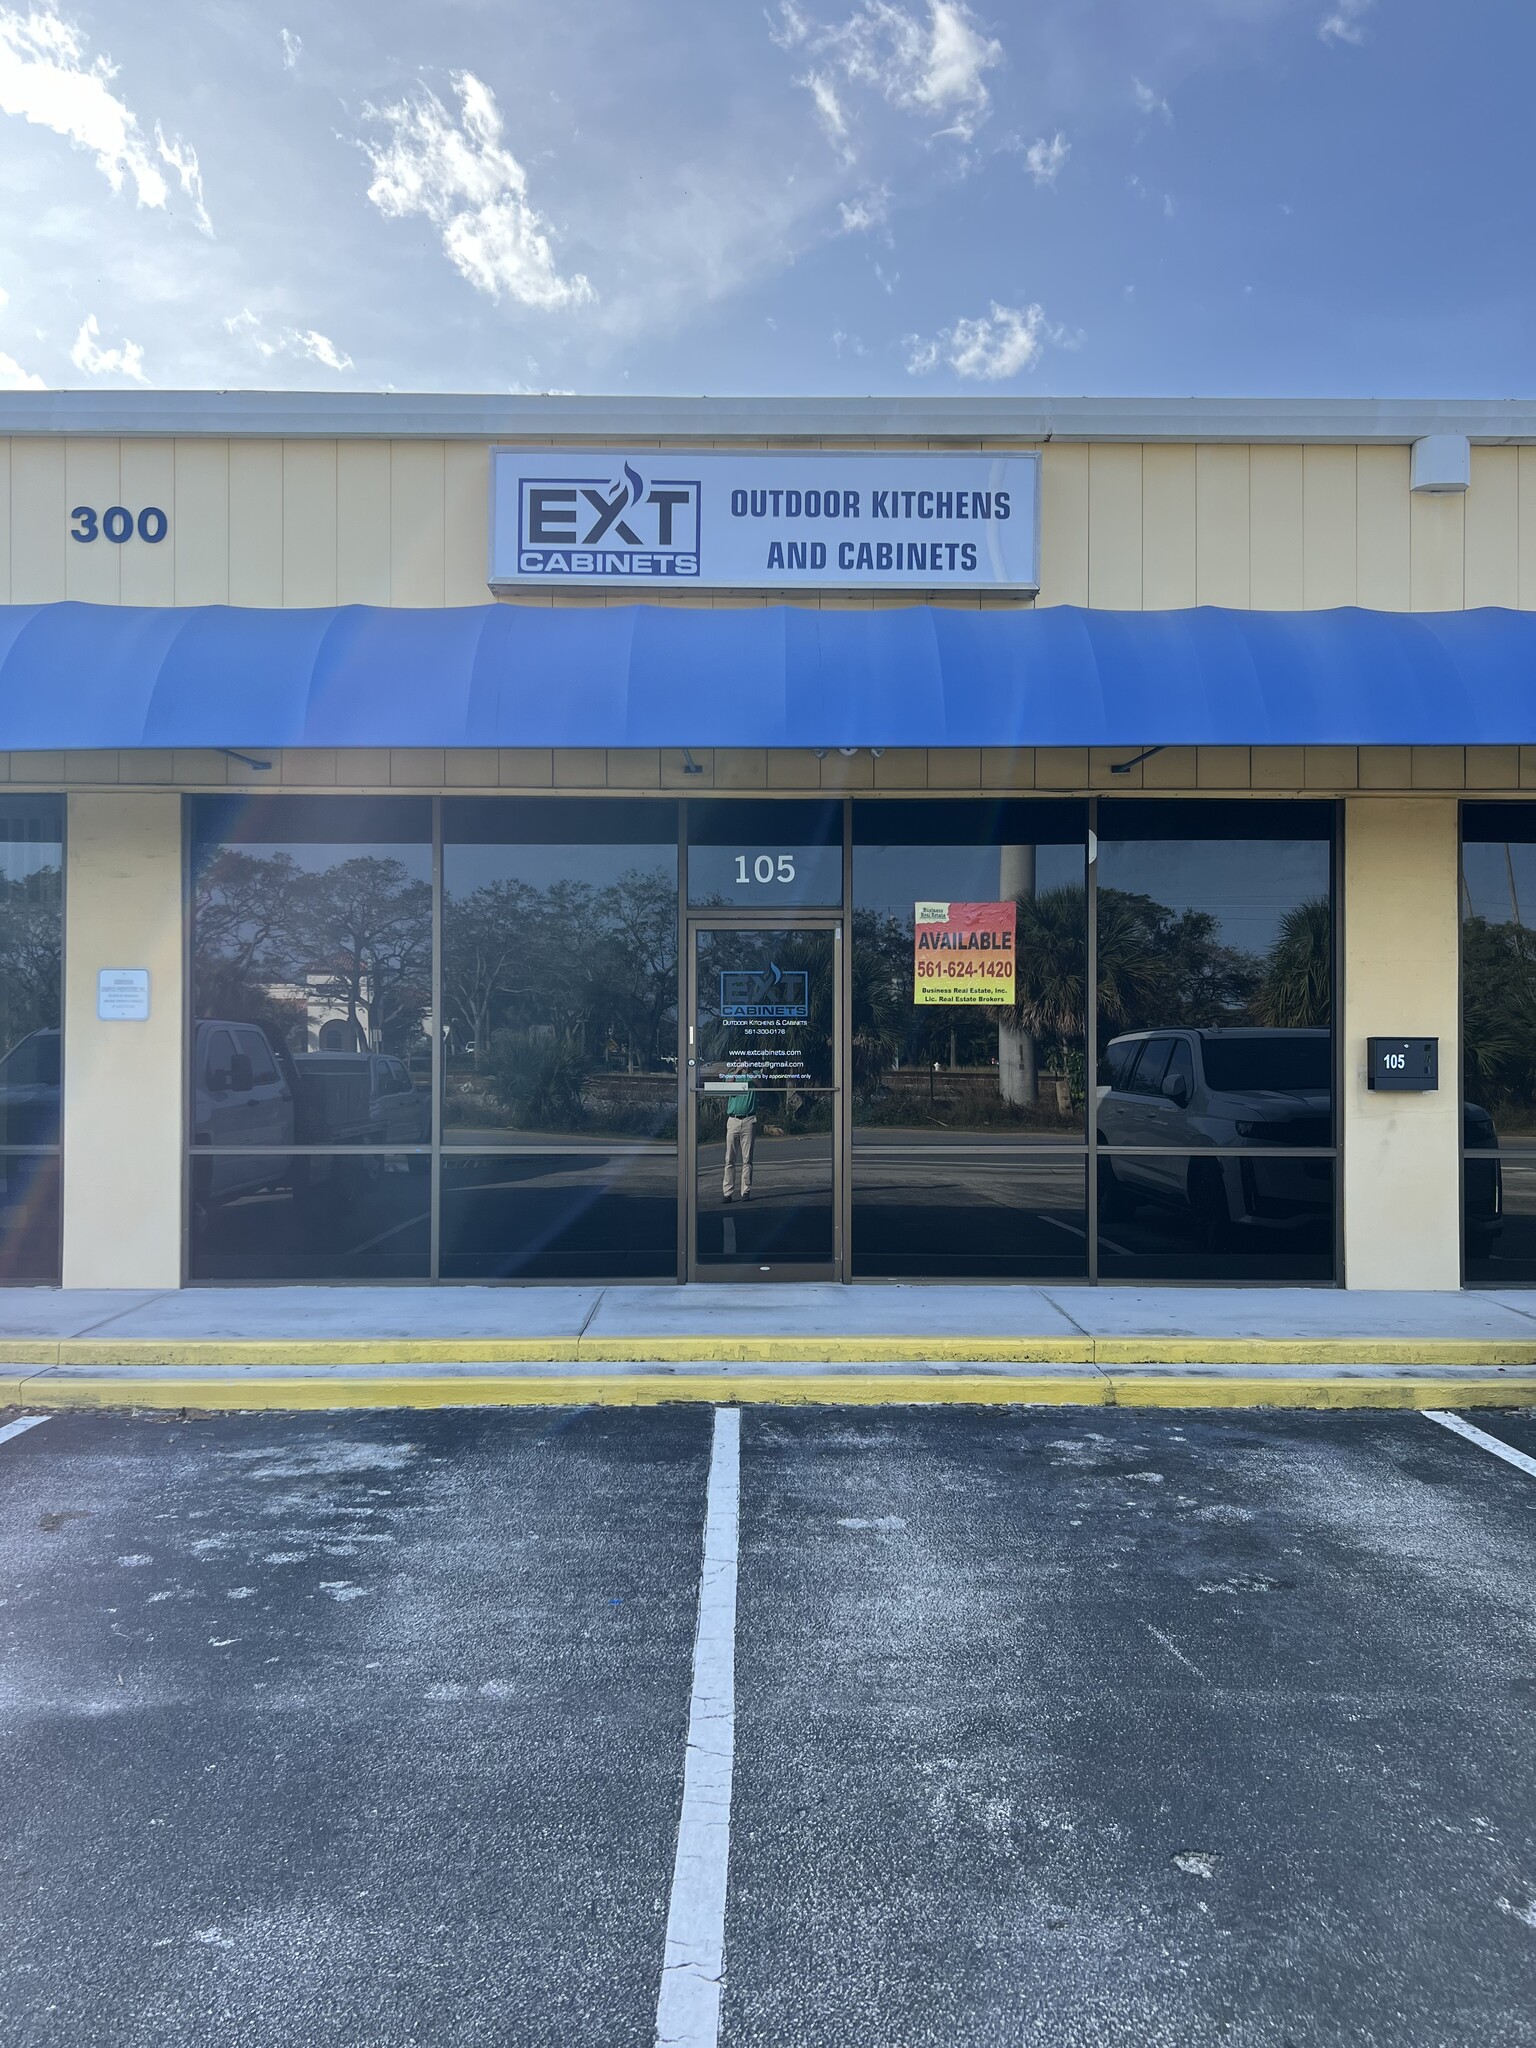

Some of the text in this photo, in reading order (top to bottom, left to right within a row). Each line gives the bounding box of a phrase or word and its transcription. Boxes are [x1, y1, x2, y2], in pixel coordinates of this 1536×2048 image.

[528, 487, 690, 545] EXT
[730, 489, 1012, 520] OUTDOOR KITCHENS
[71, 506, 168, 544] 300
[519, 552, 698, 575] CABINETS
[766, 541, 978, 571] AND CABINETS
[735, 855, 796, 883] 105
[918, 931, 1012, 950] AVAILABLE
[917, 961, 1013, 978] 561-624-1420
[725, 975, 803, 1003] EXT
[970, 987, 994, 995] Estate,
[722, 1006, 807, 1016] CABINETS
[726, 1061, 804, 1069] extcabinets@gmail.com
[1383, 1054, 1405, 1069] 105
